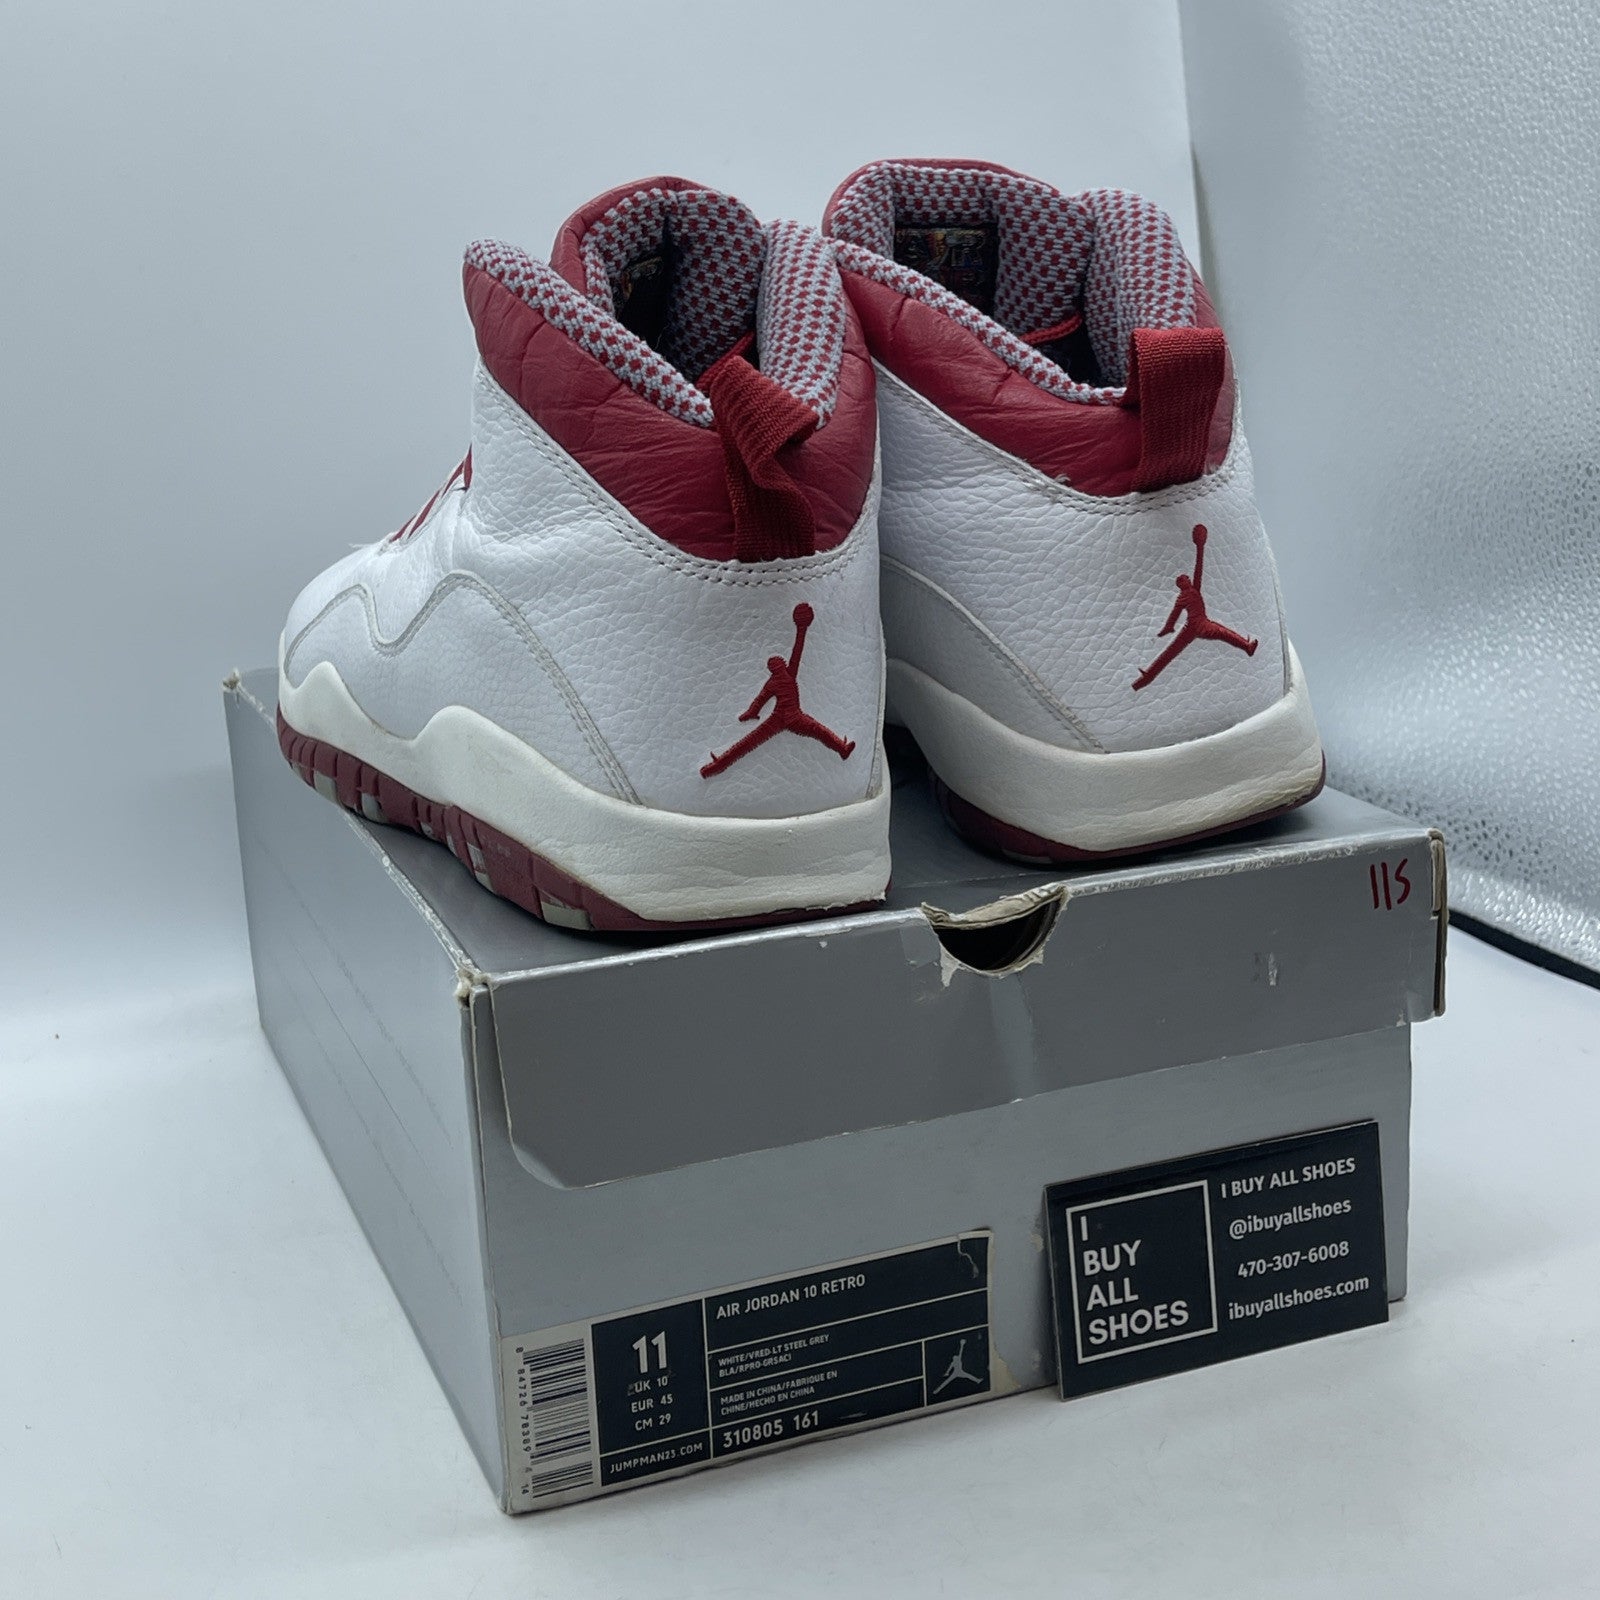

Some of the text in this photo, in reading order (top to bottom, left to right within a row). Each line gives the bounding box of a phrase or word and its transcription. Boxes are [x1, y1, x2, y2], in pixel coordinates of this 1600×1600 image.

[1231, 1176, 1265, 1198] BUY
[1269, 1169, 1299, 1189] ALL
[1302, 1157, 1356, 1182] SHOES
[1228, 1199, 1352, 1240] @ibuyallshoes
[1083, 1239, 1142, 1276] BUY
[1237, 1241, 1350, 1278] 470-307-6008
[716, 1273, 866, 1319] AIR JORDAN 10 RETRO
[1086, 1277, 1139, 1311] ALL
[1228, 1276, 1370, 1320] ibuyallshoes.com
[1088, 1300, 1190, 1345] SHOES
[632, 1330, 668, 1374] 11
[783, 1340, 808, 1353] STEEL
[809, 1334, 830, 1346] GREY
[634, 1375, 668, 1393] UK 10
[720, 1370, 838, 1406] MADE IN CHINA/FABRIQUE EN
[720, 1386, 815, 1416] CHINE/HECHO EN CHINA
[631, 1393, 673, 1413] EUR 45
[635, 1413, 672, 1431] CM 29
[723, 1410, 819, 1449] 310805 161
[609, 1442, 703, 1474] JUMPMAN23.COM
